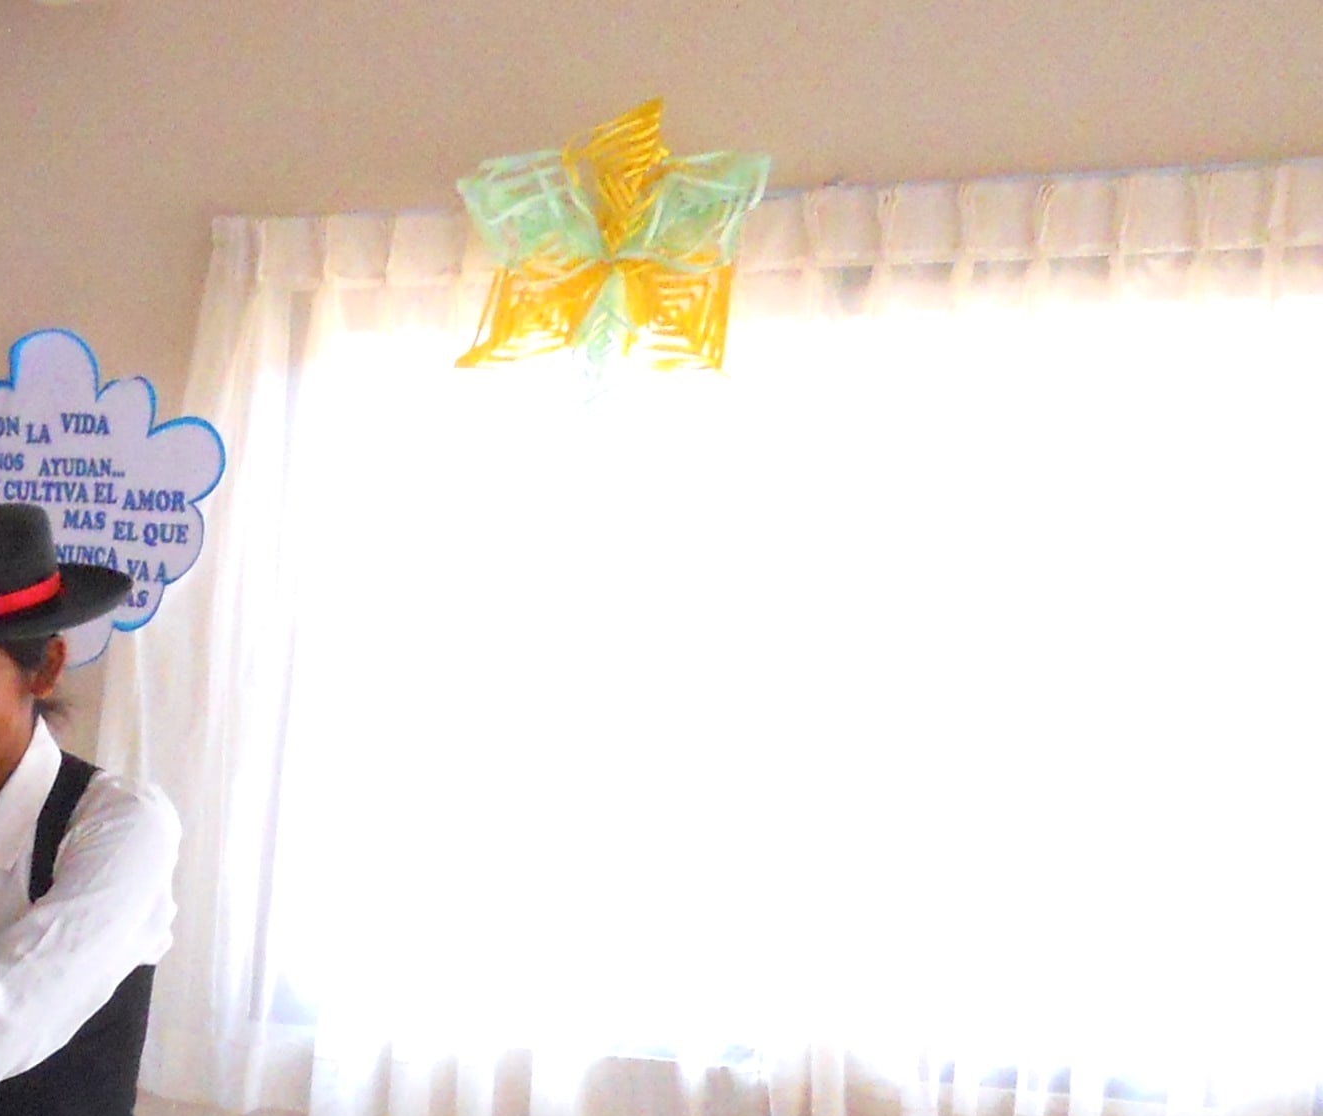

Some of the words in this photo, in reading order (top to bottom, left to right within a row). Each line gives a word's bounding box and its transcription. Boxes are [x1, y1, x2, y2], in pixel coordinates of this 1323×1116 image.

[26, 424, 51, 443] LA
[61, 413, 110, 435] VIDA
[4, 480, 90, 503] CULTIVA
[94, 482, 117, 504] EL
[122, 490, 186, 512] AMOR
[63, 510, 106, 530] MAS
[113, 521, 138, 541] EL
[143, 523, 189, 546] QUE
[55, 545, 118, 570] NUNCA
[127, 558, 149, 581] VA
[154, 561, 168, 582] A
